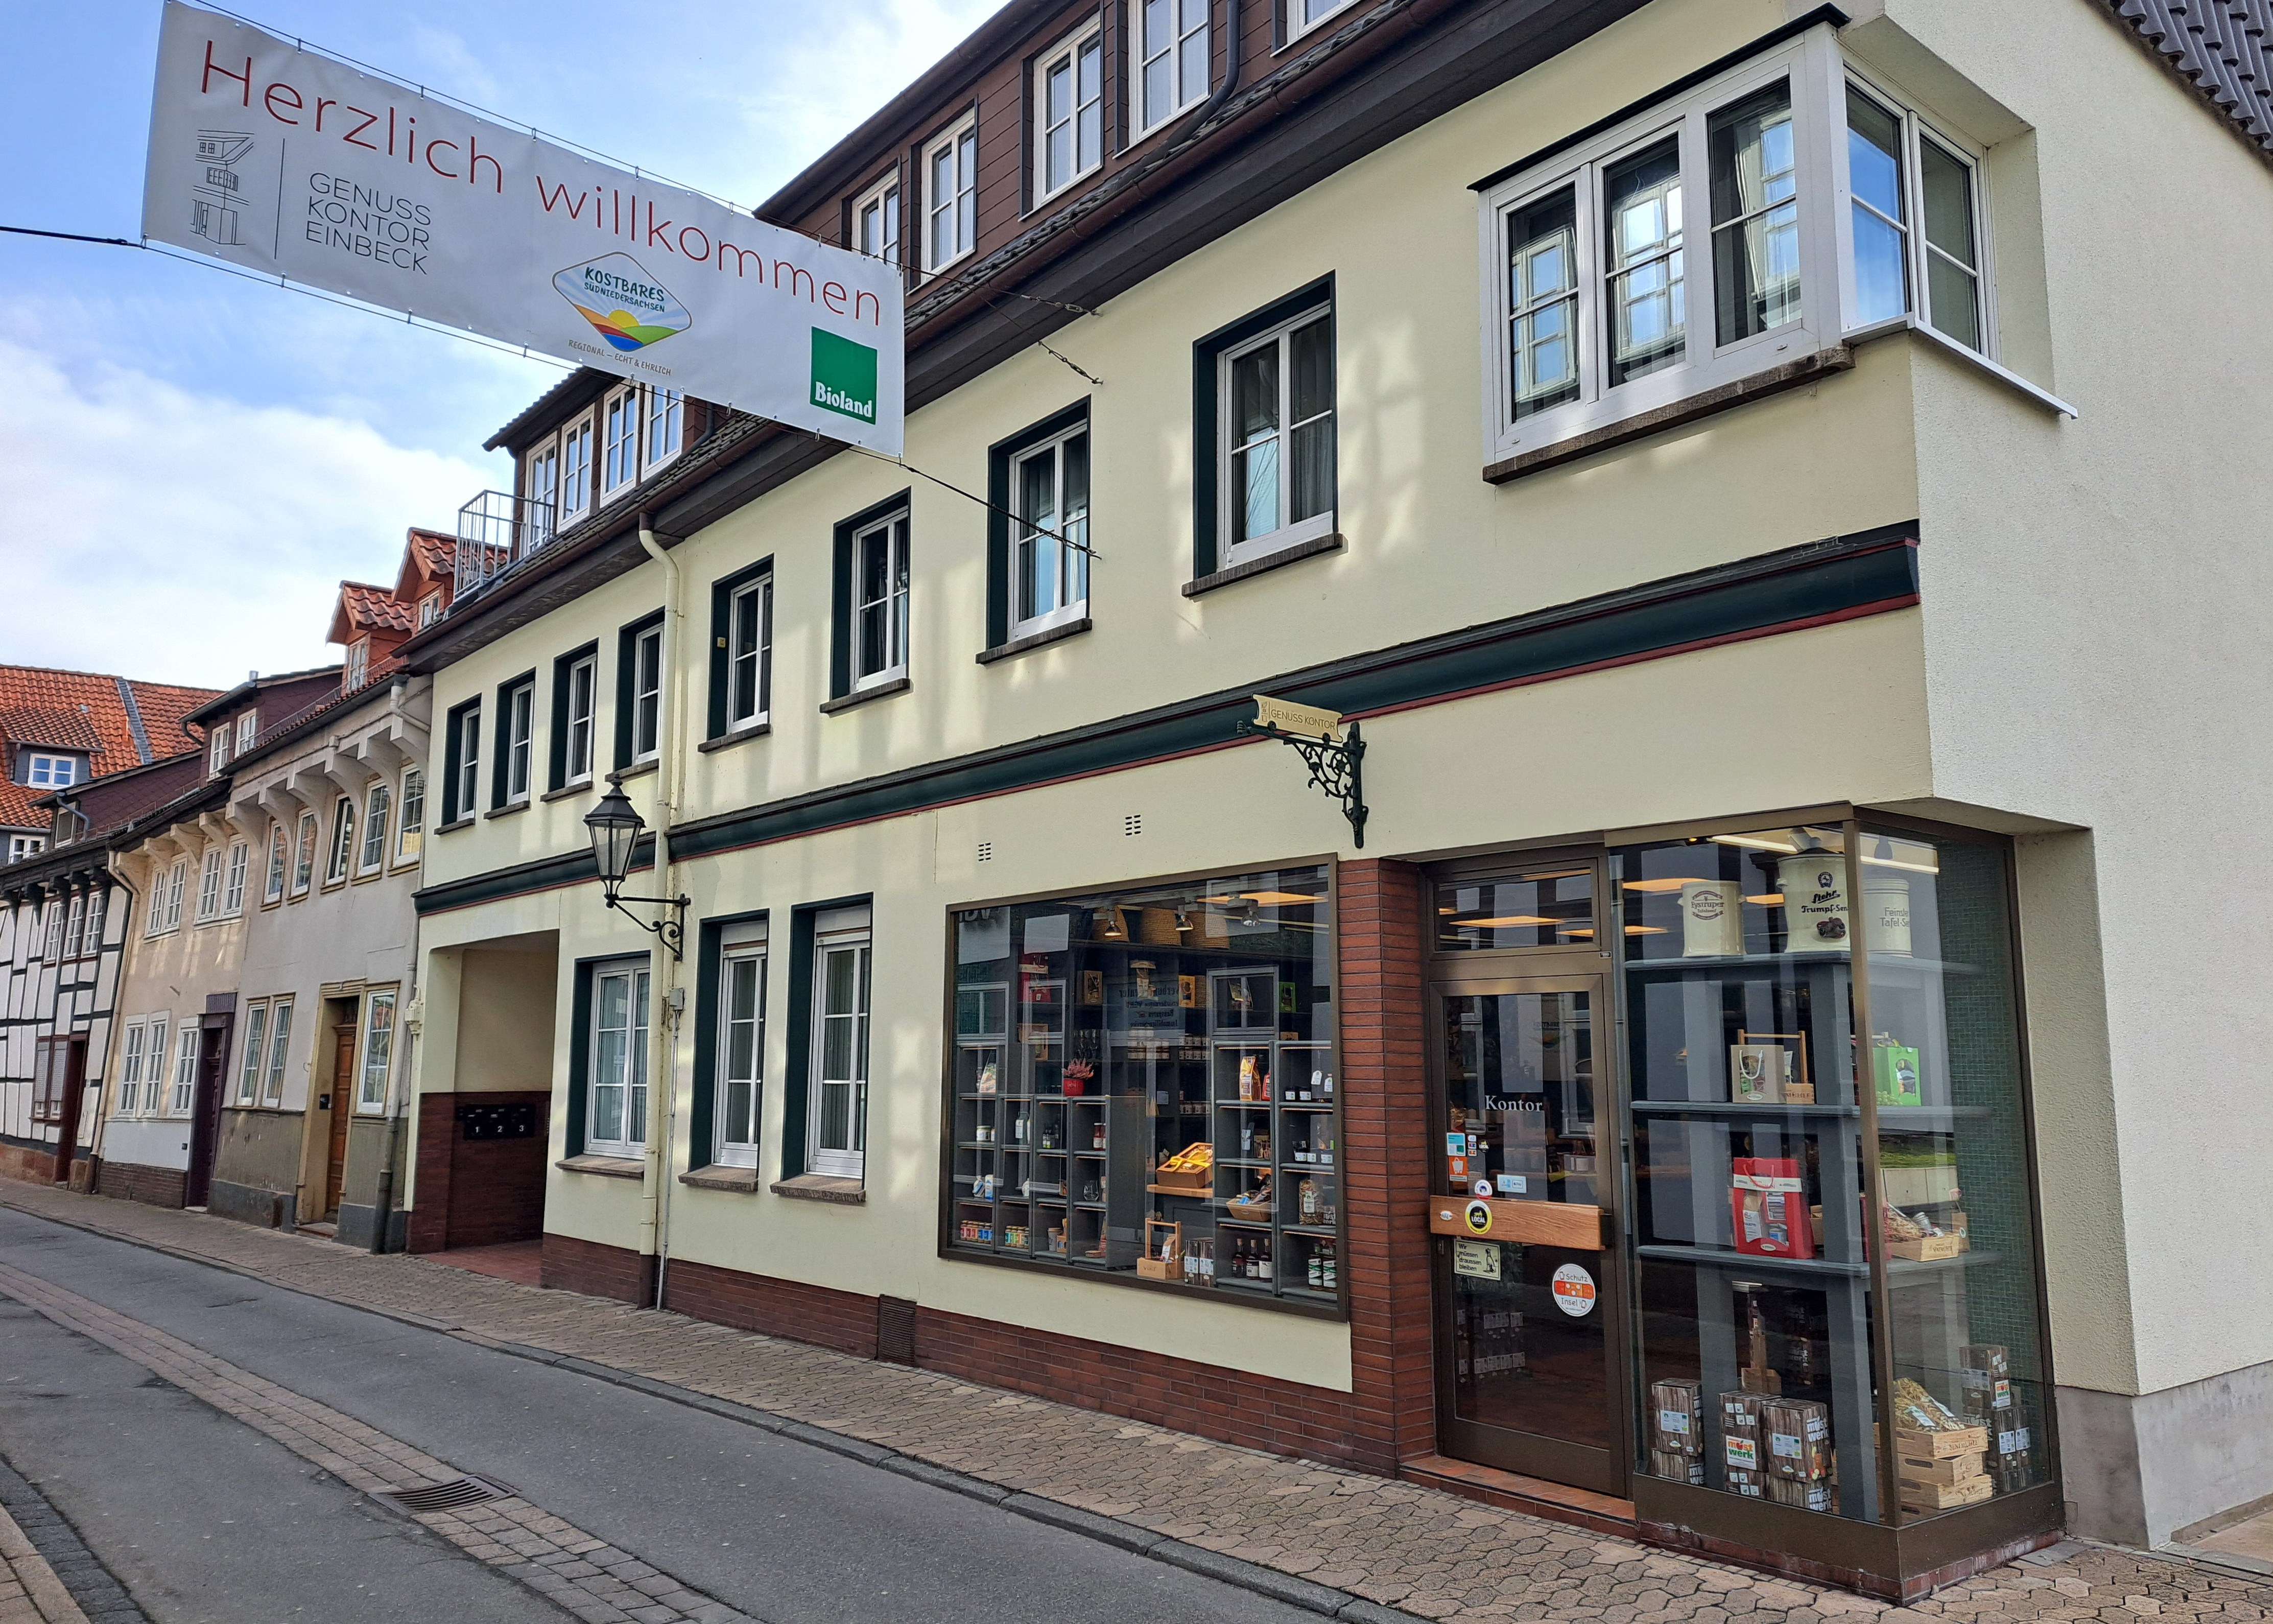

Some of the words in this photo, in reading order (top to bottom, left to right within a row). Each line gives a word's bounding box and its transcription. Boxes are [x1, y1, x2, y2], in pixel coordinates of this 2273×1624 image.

[202, 40, 502, 194] Herzlich
[536, 175, 880, 326] willkommen
[309, 173, 431, 226] GENUSS
[308, 196, 430, 251] KONTOR
[306, 220, 428, 275] EINBECK
[584, 266, 665, 302] KOSTBARES
[584, 281, 665, 313] SÜDNIEDERSACHSEN
[568, 339, 605, 357] REGIONAL
[614, 354, 633, 364] ECHT
[641, 361, 671, 376] EHRLICH
[815, 382, 872, 417] Bioland
[1271, 709, 1303, 723] GENUSS
[1305, 716, 1335, 730] KONTOR
[1802, 904, 1849, 913] Trumpf-Sen
[1880, 917, 1909, 929] Tafel-Se
[1485, 1095, 1543, 1112] Kontor
[1566, 1274, 1588, 1282] Schutz
[1561, 1298, 1578, 1306] Insel
[1729, 1448, 1754, 1460] werk
